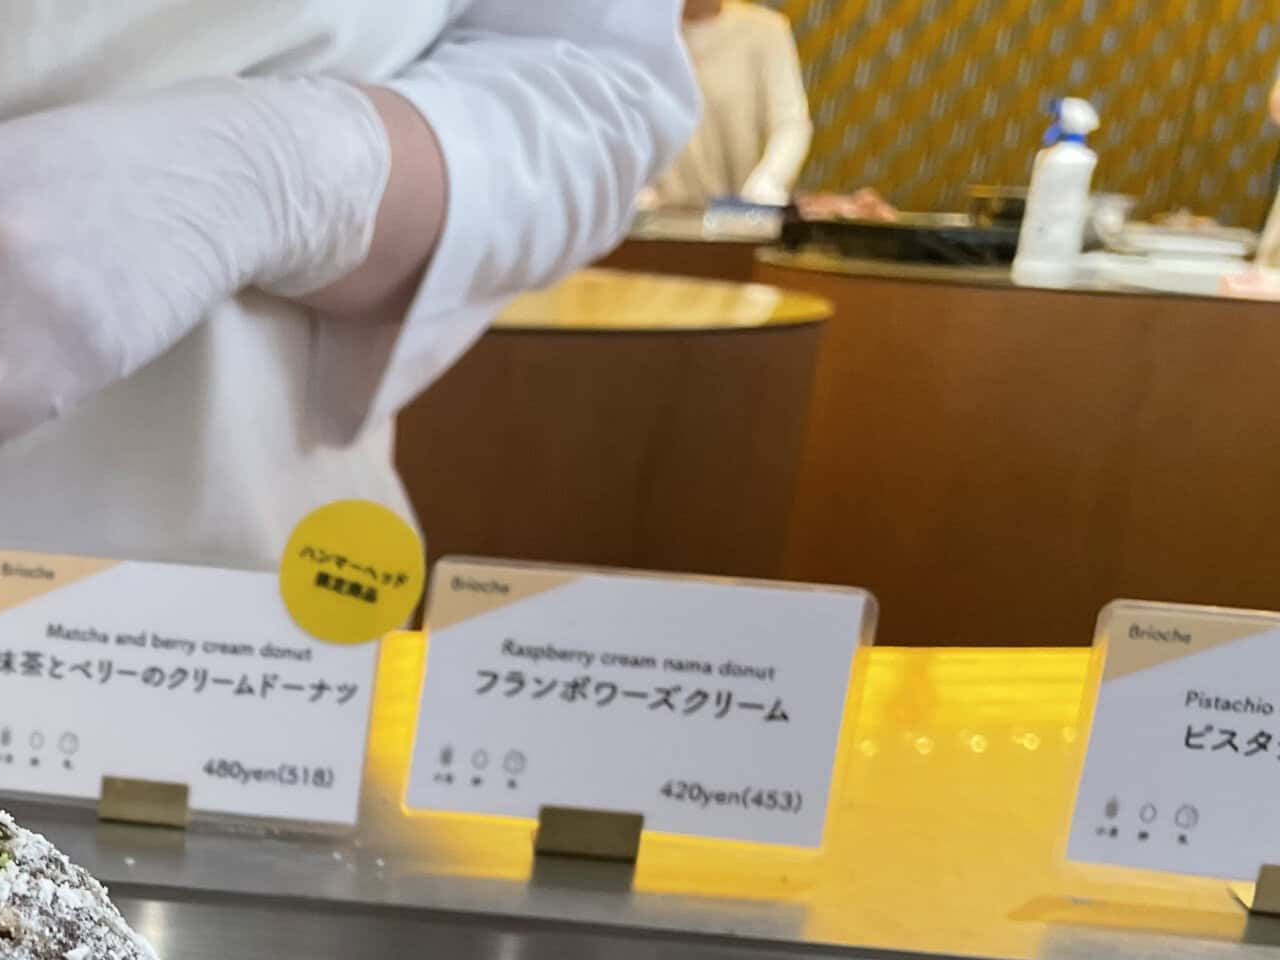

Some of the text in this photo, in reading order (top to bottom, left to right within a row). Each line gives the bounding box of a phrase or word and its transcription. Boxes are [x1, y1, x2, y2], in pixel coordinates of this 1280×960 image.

[450, 575, 511, 597] Brioche
[45, 622, 313, 663] Matcha and berry cream donut
[1128, 623, 1193, 645] Brioche
[501, 638, 777, 681] Raspberry cream nama donut
[1184, 689, 1275, 716] Pistachio
[1183, 724, 1280, 761] ピスタ
[202, 758, 335, 789] 480yen(518)
[659, 780, 803, 815] 420yen(453)
